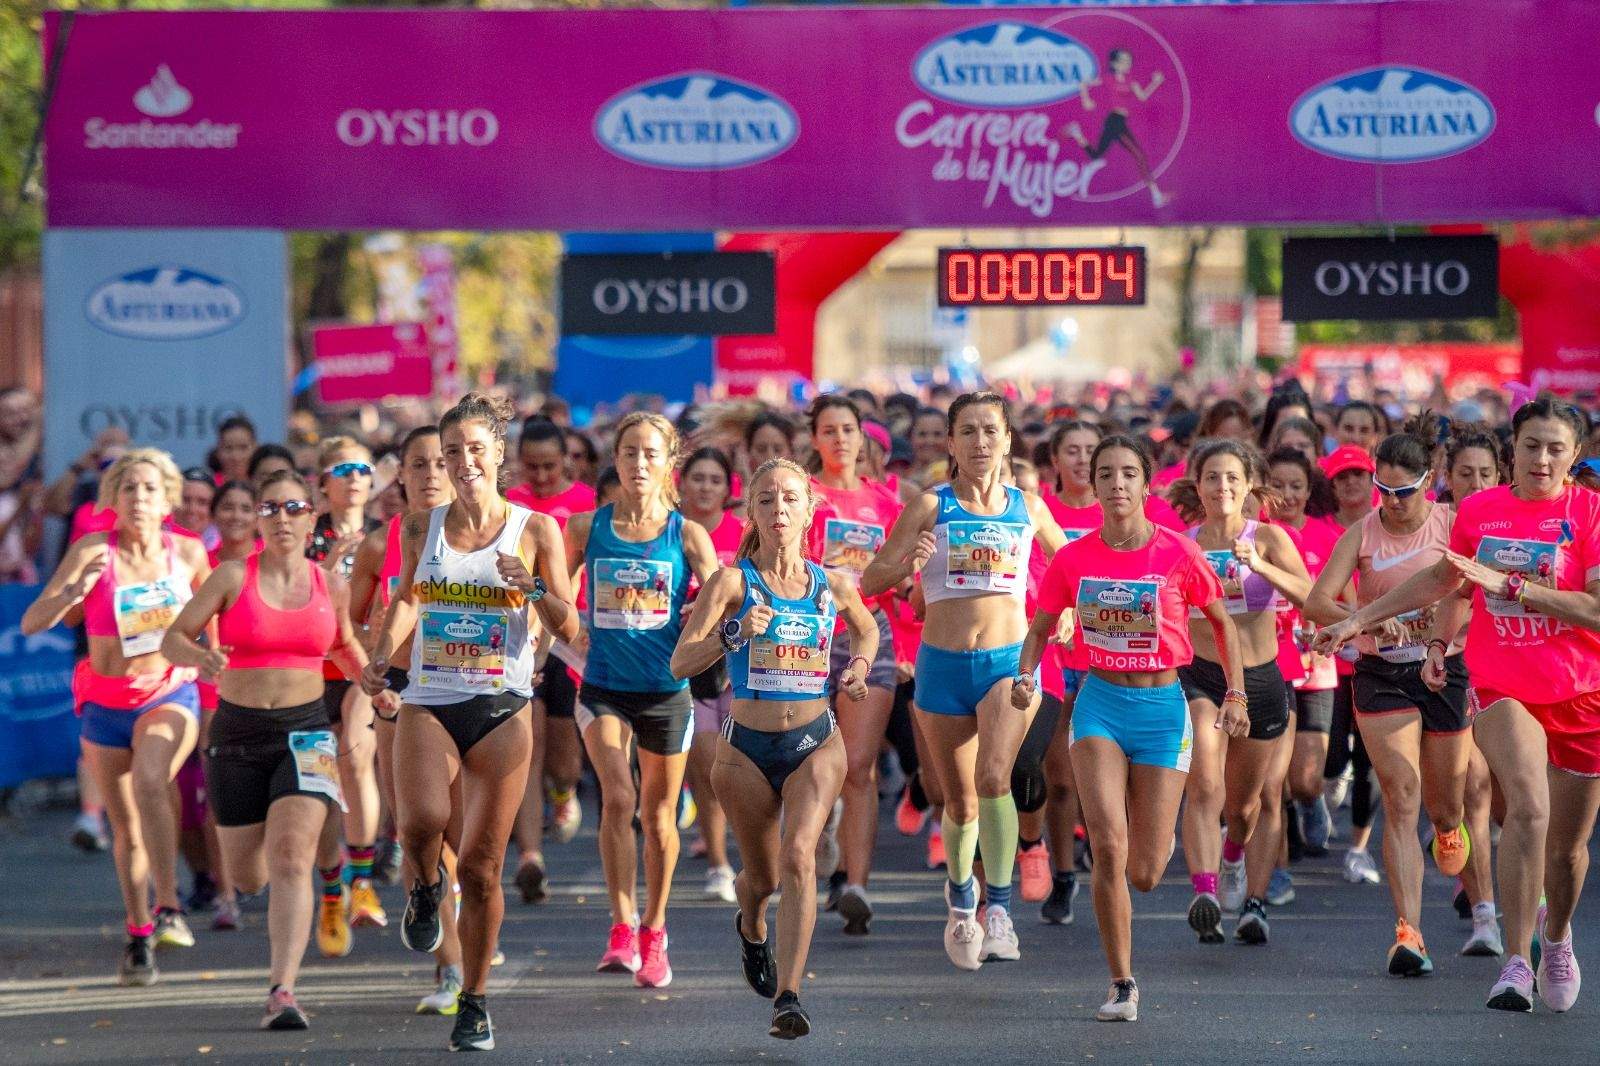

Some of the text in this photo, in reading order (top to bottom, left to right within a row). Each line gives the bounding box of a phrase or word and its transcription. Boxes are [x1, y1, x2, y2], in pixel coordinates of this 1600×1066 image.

[929, 54, 1082, 86] ASTURIANA
[84, 117, 242, 148] Santander
[337, 108, 498, 147] OYSHO
[612, 109, 782, 144] ASTURIANA
[895, 101, 1050, 148] Carrera
[1308, 102, 1478, 138] ASTURIANA
[932, 139, 1107, 218] de la Mujer
[1314, 260, 1470, 297] OYSHO
[593, 277, 748, 315] OYSHO
[972, 549, 1002, 562] 016
[420, 575, 505, 600] eMotion
[1100, 593, 1132, 601] ASTURIANA
[435, 598, 487, 613] running
[1099, 609, 1132, 623] 016
[447, 625, 481, 635] ASTURIANA
[777, 627, 809, 637] ASTURIANA
[445, 642, 481, 658] 016
[775, 644, 808, 661] 016
[1089, 650, 1167, 669] TU DORSAL
